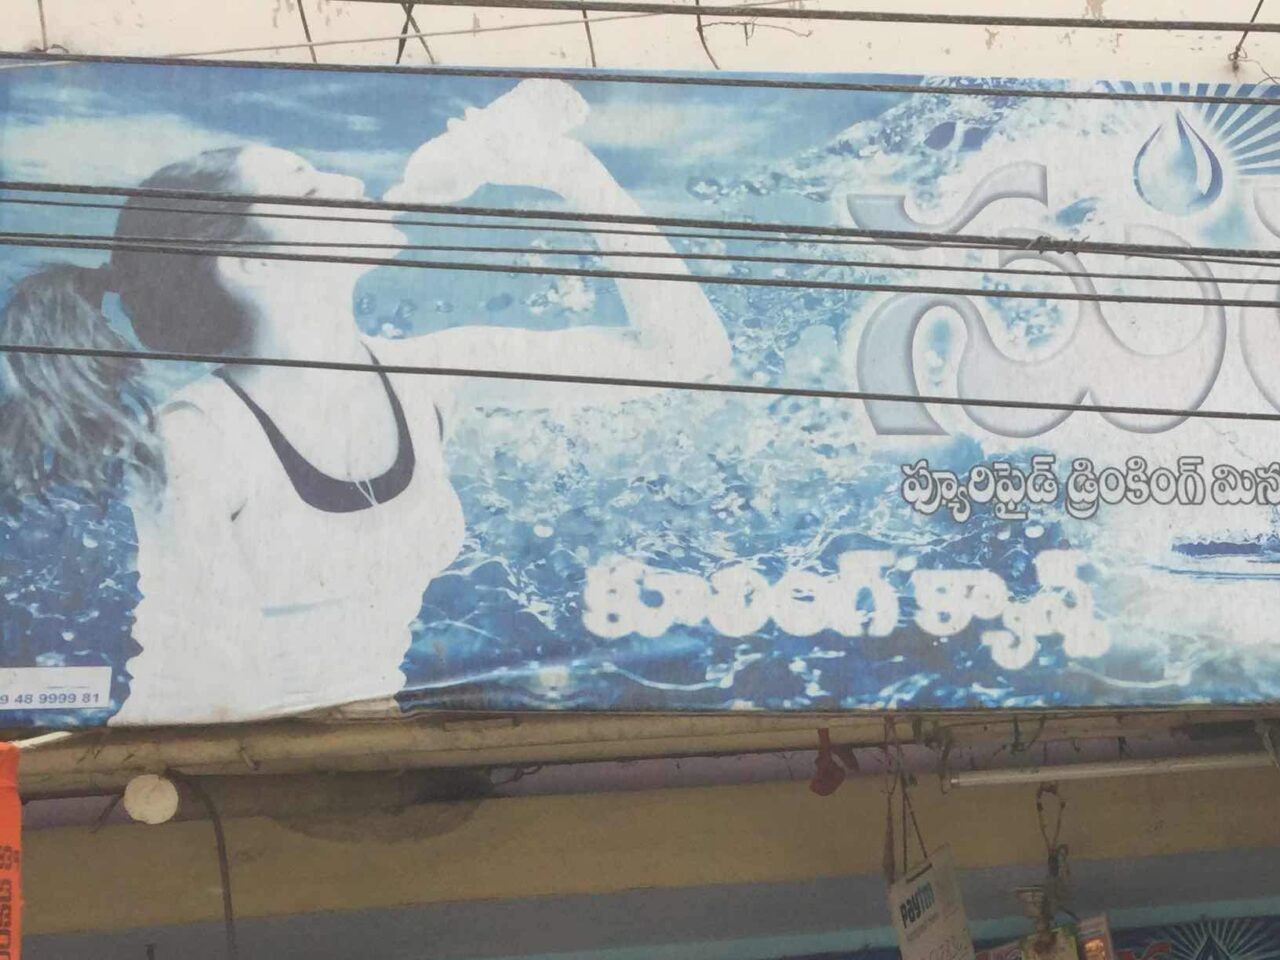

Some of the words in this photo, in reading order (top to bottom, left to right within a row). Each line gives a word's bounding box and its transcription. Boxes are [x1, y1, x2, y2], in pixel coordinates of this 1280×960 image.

[1065, 455, 1206, 520] డ్రింకింగ్
[14, 694, 34, 704] 48
[39, 693, 77, 704] 9999
